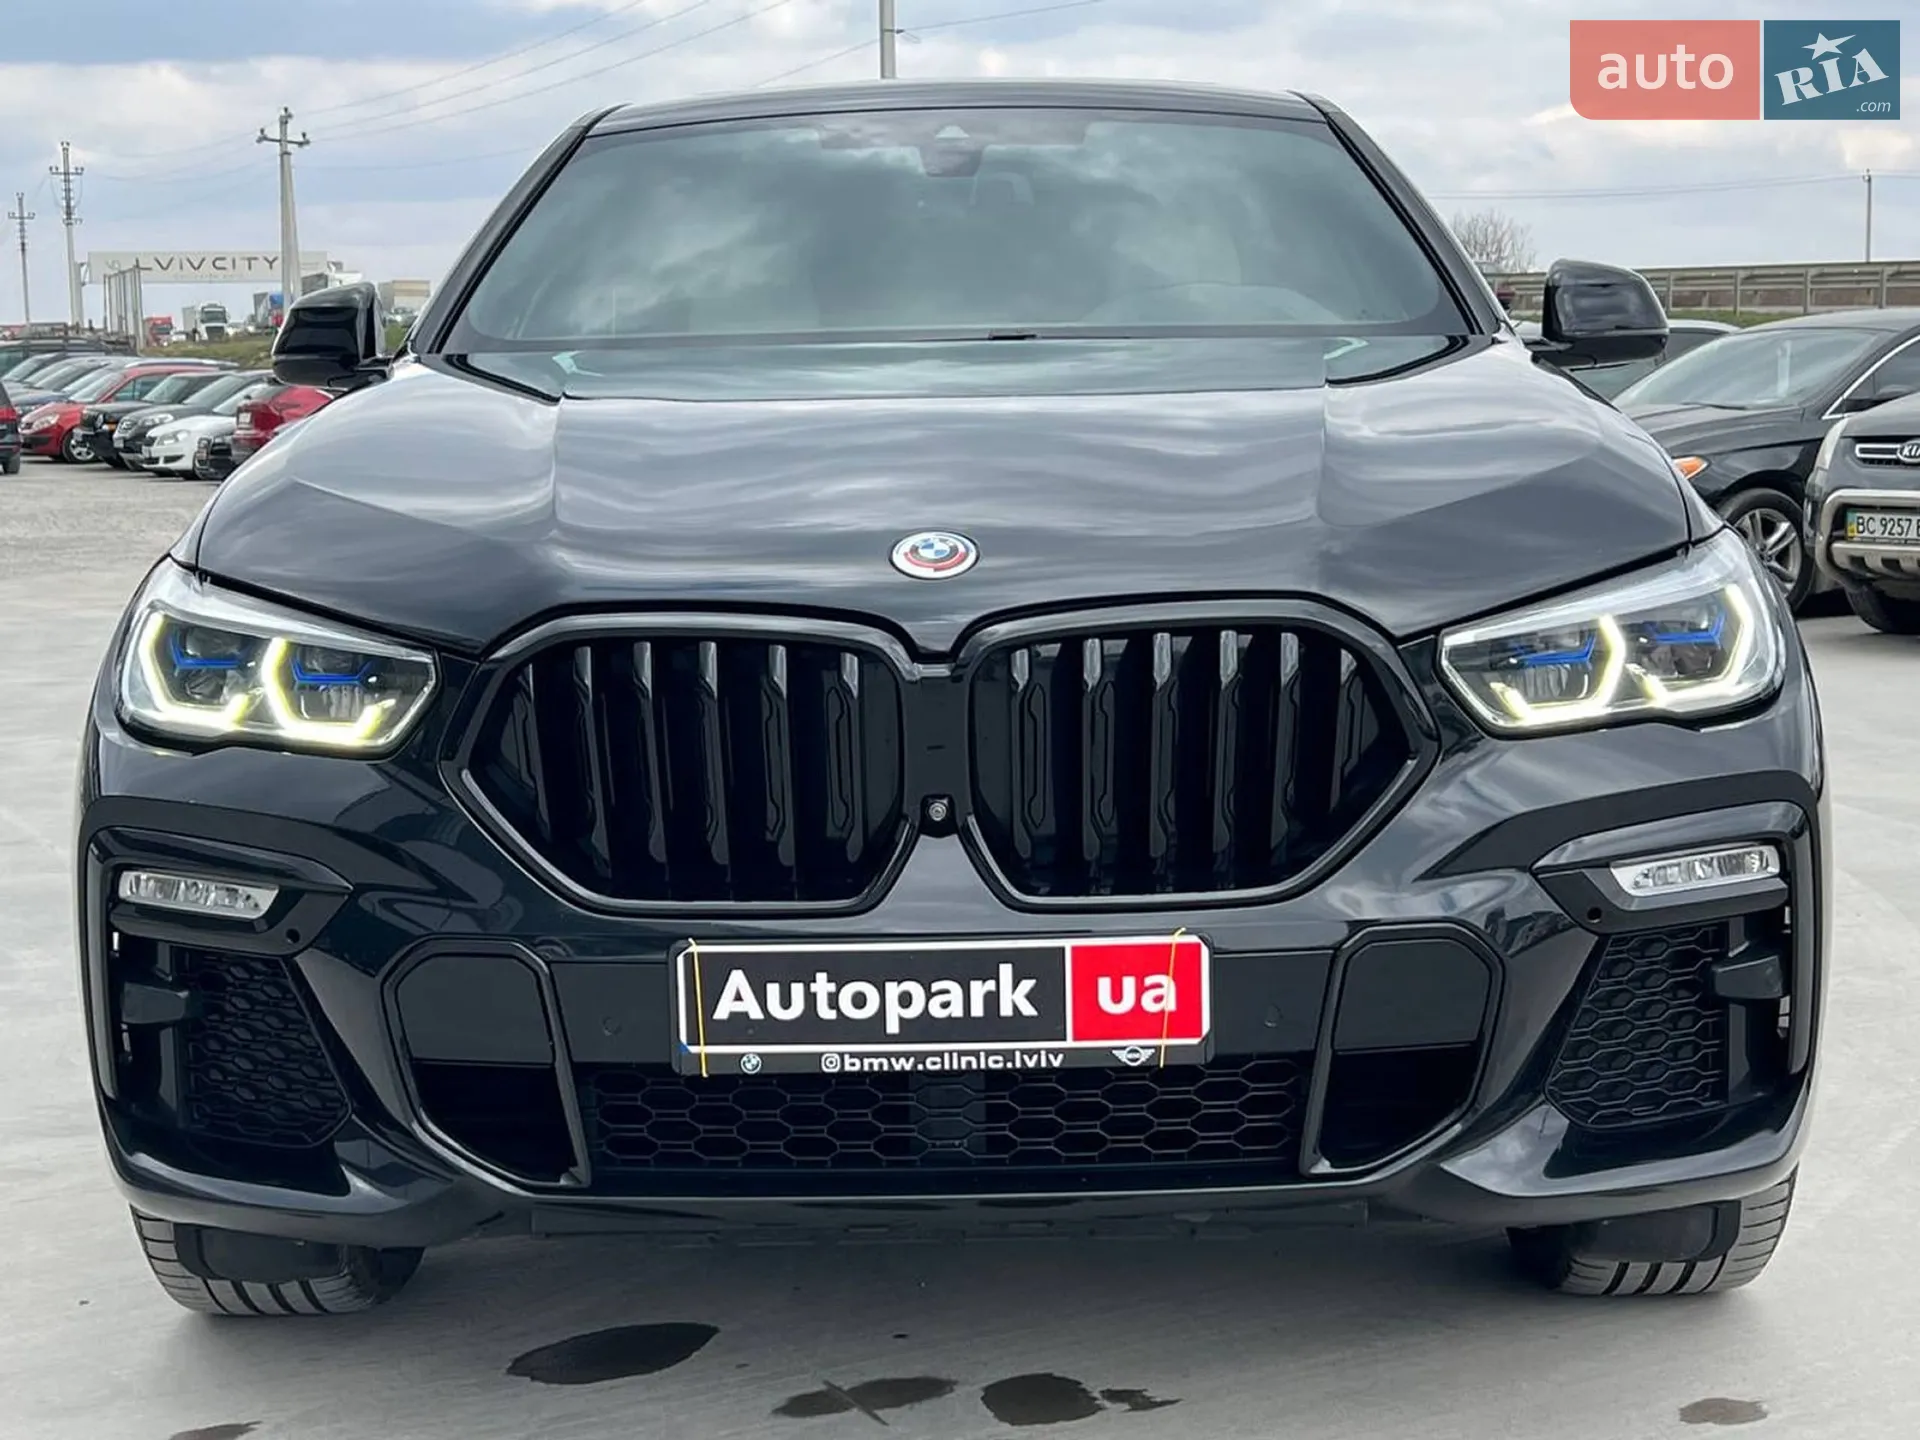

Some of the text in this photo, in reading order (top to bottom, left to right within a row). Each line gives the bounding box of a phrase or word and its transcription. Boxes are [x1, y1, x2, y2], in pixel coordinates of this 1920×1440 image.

[1856, 516, 1876, 535] BC
[1880, 517, 1912, 536] 9257
[713, 963, 1177, 1034] Autopark ua
